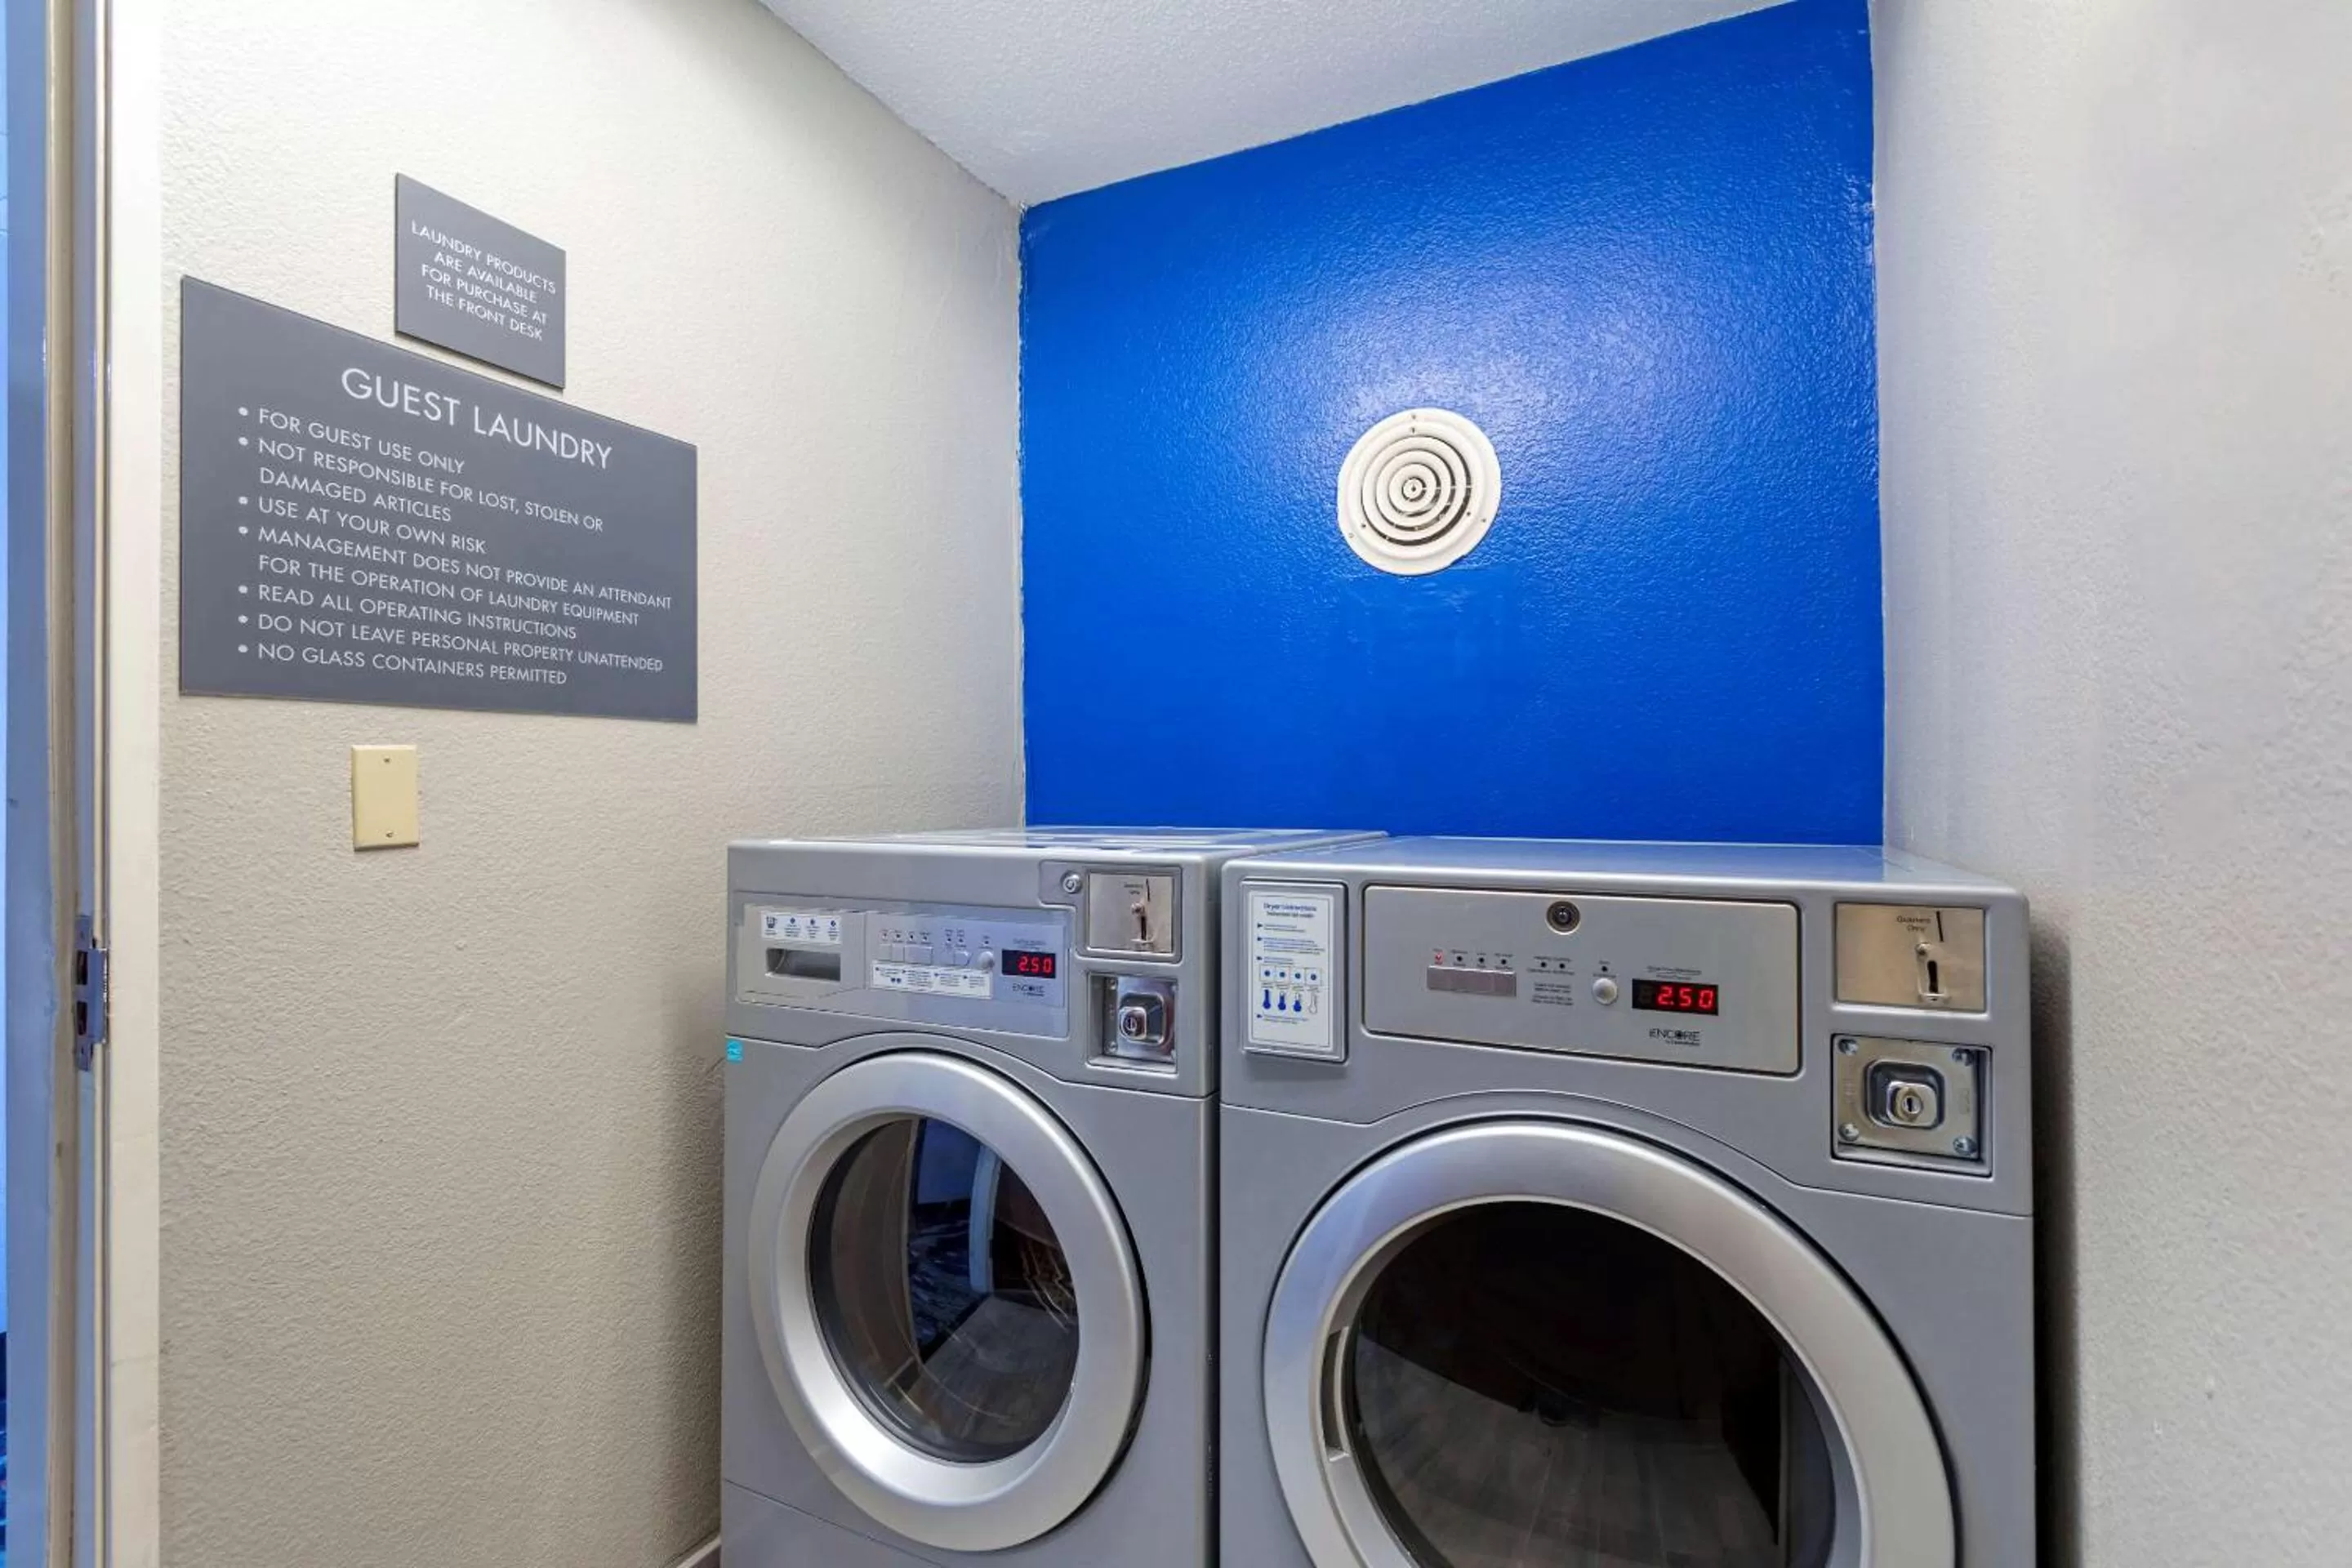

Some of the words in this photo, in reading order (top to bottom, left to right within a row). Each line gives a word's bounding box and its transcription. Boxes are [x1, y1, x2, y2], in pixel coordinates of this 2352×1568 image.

[412, 220, 481, 261] LAUNDRY
[487, 253, 556, 294] PRODUCTS
[434, 252, 462, 272] ARE
[467, 265, 537, 304] AVAILABLE
[421, 264, 451, 287] FOR
[457, 278, 528, 318] PURCHASE
[532, 310, 546, 324] AT
[426, 284, 454, 307] THE
[458, 297, 505, 326] FRONT
[510, 318, 542, 341] DESK
[259, 408, 301, 434] FOR
[308, 422, 372, 451] GUEST
[378, 439, 412, 462] USE
[417, 451, 465, 474] ONLY
[341, 368, 461, 426] GUEST
[474, 405, 612, 470] LAUNDRY
[258, 438, 306, 462] NOT
[314, 451, 434, 493] RESPONSIBLE
[440, 481, 473, 502] FOR
[479, 490, 519, 514] LOST,
[524, 501, 579, 525] STOLEN
[582, 515, 603, 532] OR
[260, 466, 367, 504] DAMAGED
[373, 493, 452, 522] ARTICLES
[259, 496, 298, 519] USE
[305, 506, 330, 524] AT
[336, 510, 390, 537] YOUR
[396, 524, 445, 546] OWN
[452, 533, 486, 554] RISK
[258, 526, 407, 565] MANAGEMENT
[413, 552, 460, 575] DOES
[466, 563, 501, 581] NOT
[506, 569, 568, 592] PROVIDE
[572, 581, 594, 597] AN
[598, 586, 671, 608] ATTENDANT
[259, 555, 301, 577] FOR
[308, 562, 344, 583] THE
[351, 570, 454, 599] OPERATION
[460, 587, 483, 603] OF
[488, 590, 558, 613] LAUNDRY
[563, 602, 639, 626] EQUIPMENT
[259, 584, 314, 606] READ
[320, 594, 354, 612] ALL
[359, 598, 462, 625] OPERATING
[468, 612, 577, 639] INSTRUCTIONS
[258, 643, 295, 662] NO
[301, 647, 365, 667] GLASS
[372, 653, 484, 678] CONTAINERS
[490, 664, 567, 684] PERMITTED
[259, 613, 293, 632] DO
[300, 618, 345, 638] NOT
[351, 623, 405, 644] LEAVE
[412, 630, 499, 655] PERSONAL
[504, 641, 573, 662] PROPERTY
[577, 651, 663, 672] UNATTENDED
[1657, 985, 1714, 1009] 2.50
